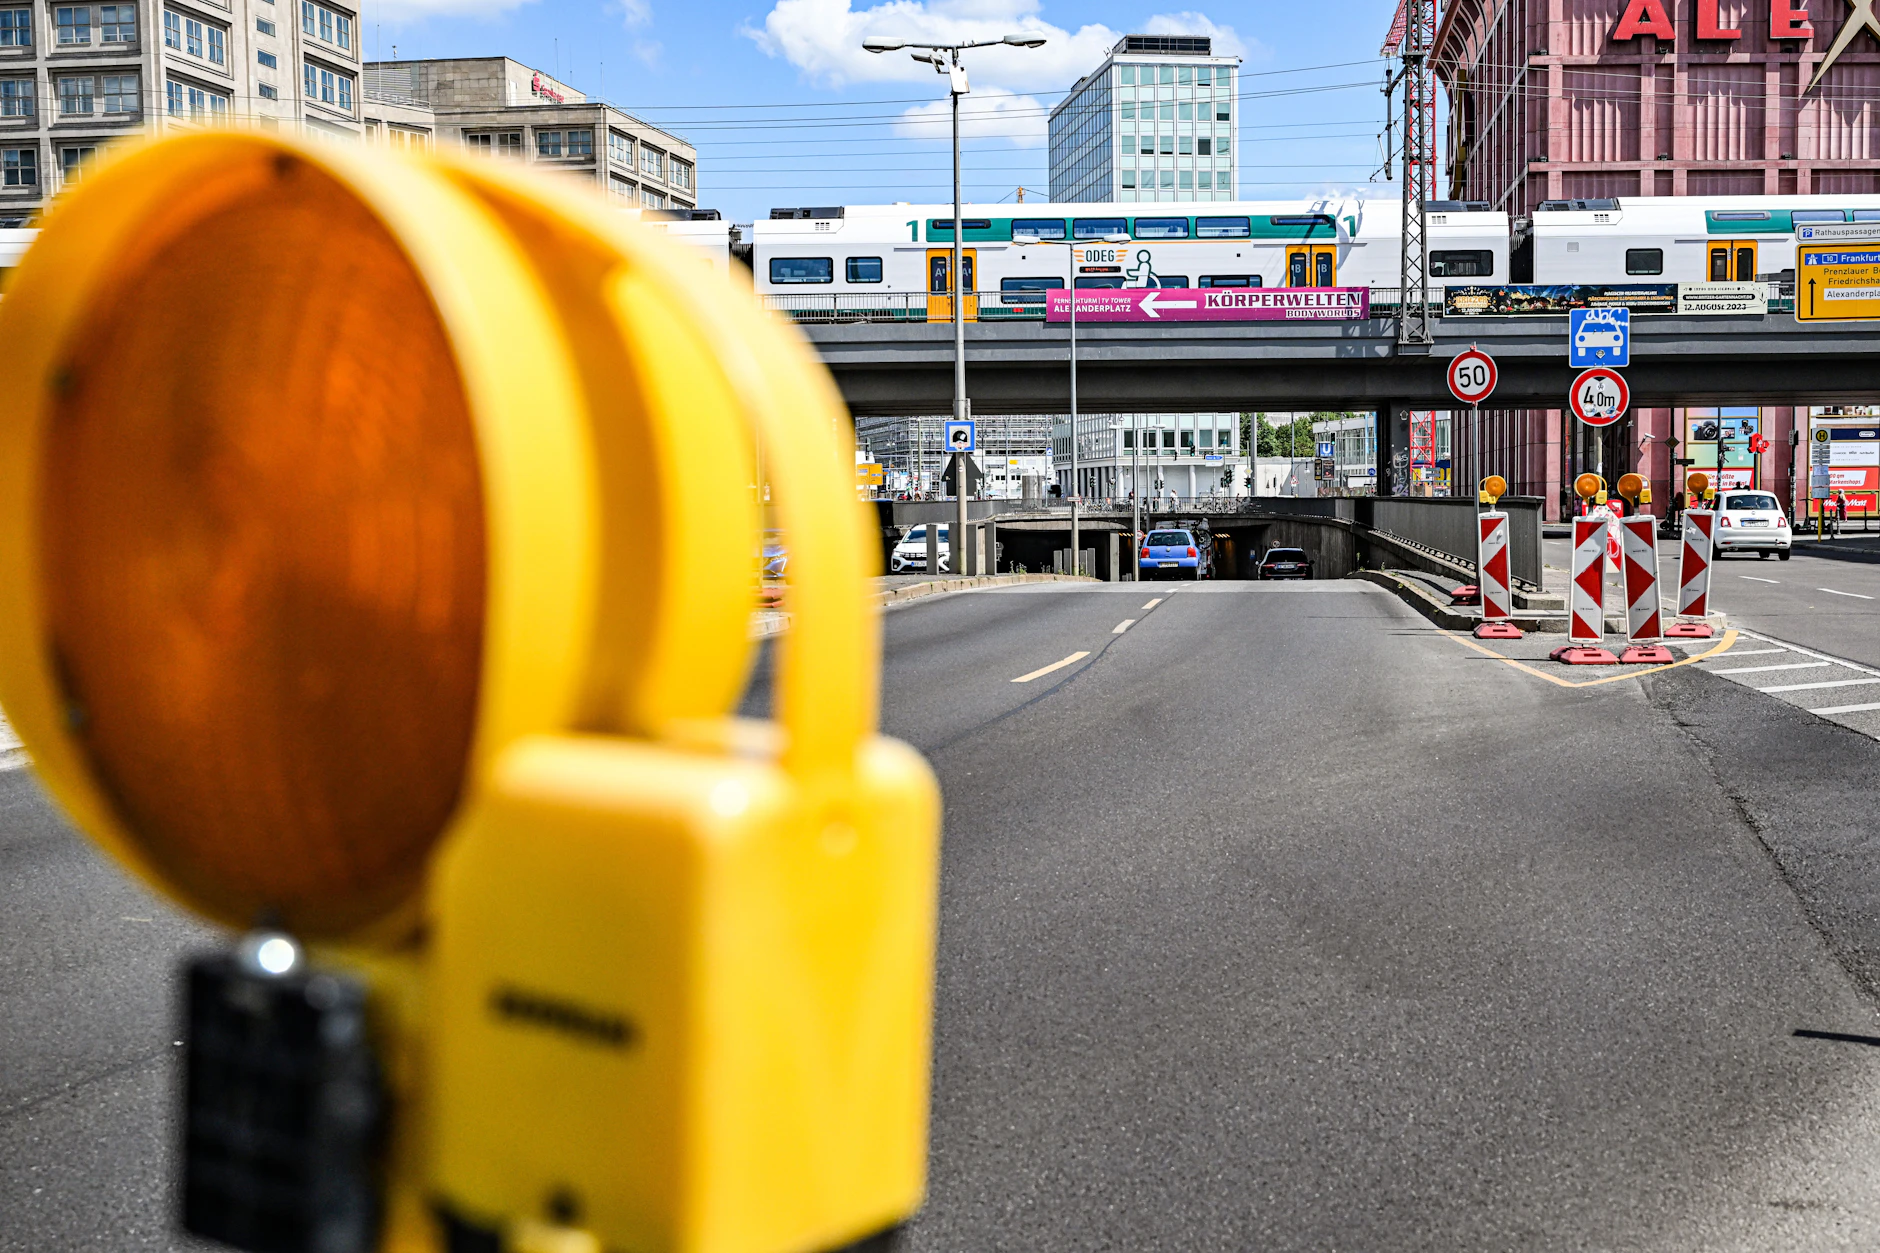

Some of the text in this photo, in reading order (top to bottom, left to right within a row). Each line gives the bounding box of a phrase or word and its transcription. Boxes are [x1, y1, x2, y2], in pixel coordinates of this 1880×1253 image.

[906, 219, 918, 242] 1
[1343, 215, 1356, 237] 1
[1085, 249, 1114, 262] ODEG
[1824, 267, 1869, 275] Prenzlauer
[1207, 291, 1360, 307] KÖRPERWELTEN
[1459, 365, 1485, 388] 50
